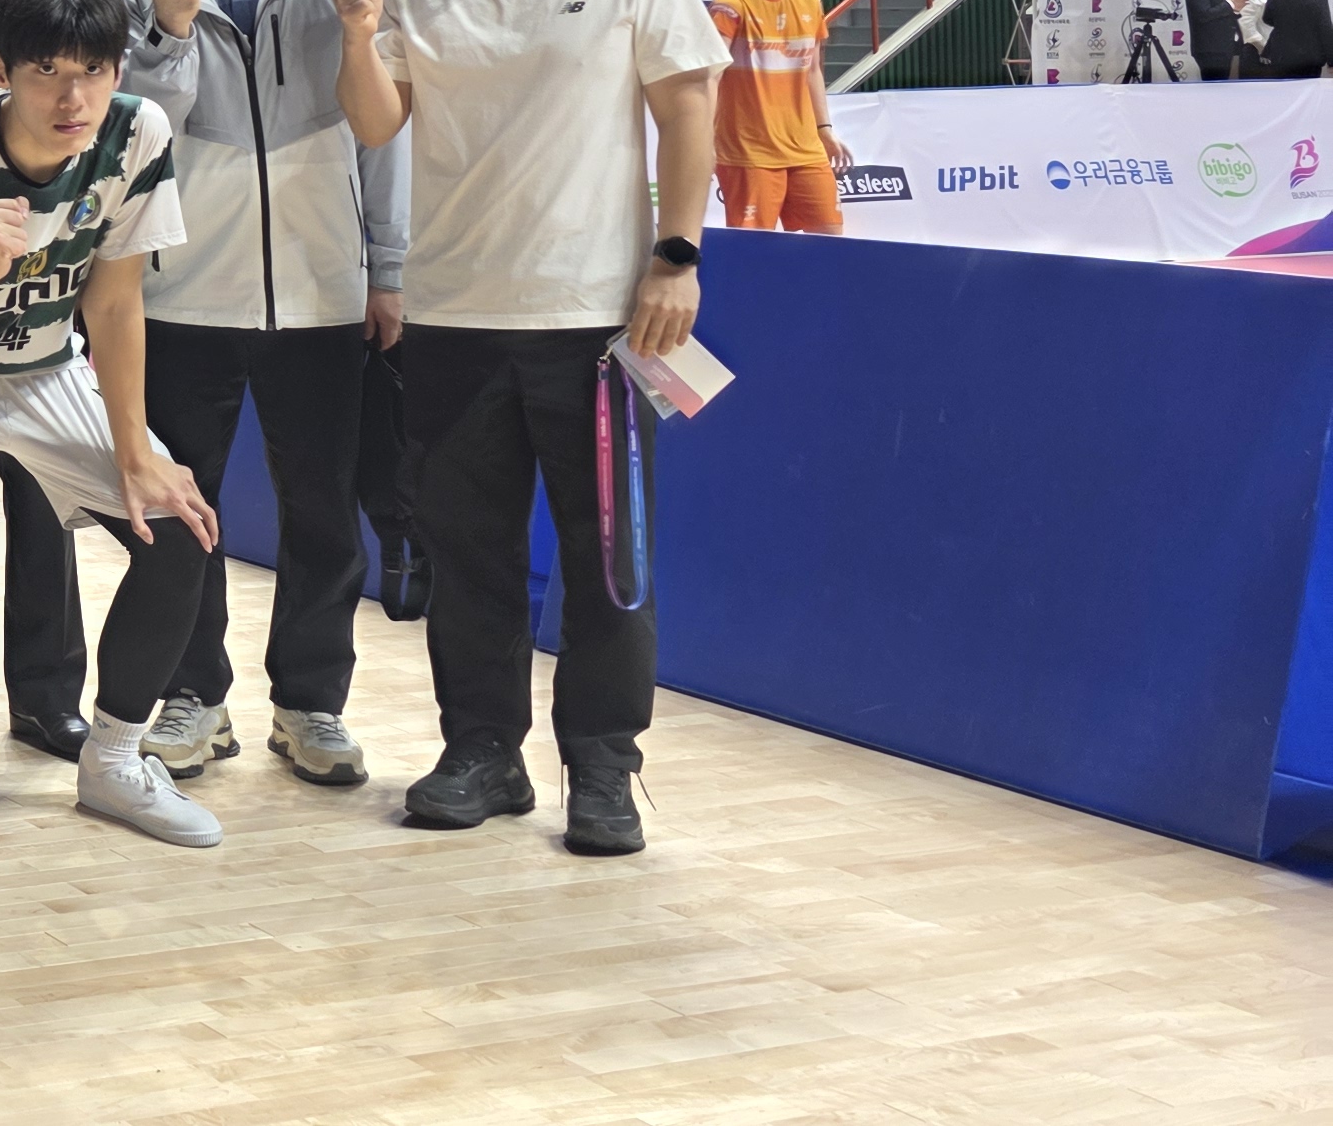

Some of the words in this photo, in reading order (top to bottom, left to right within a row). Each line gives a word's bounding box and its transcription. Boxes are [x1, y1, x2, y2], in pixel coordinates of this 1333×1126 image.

[1073, 159, 1174, 187] 우리금융그룹
[1202, 159, 1252, 181] bibigo
[856, 174, 905, 193] sleep
